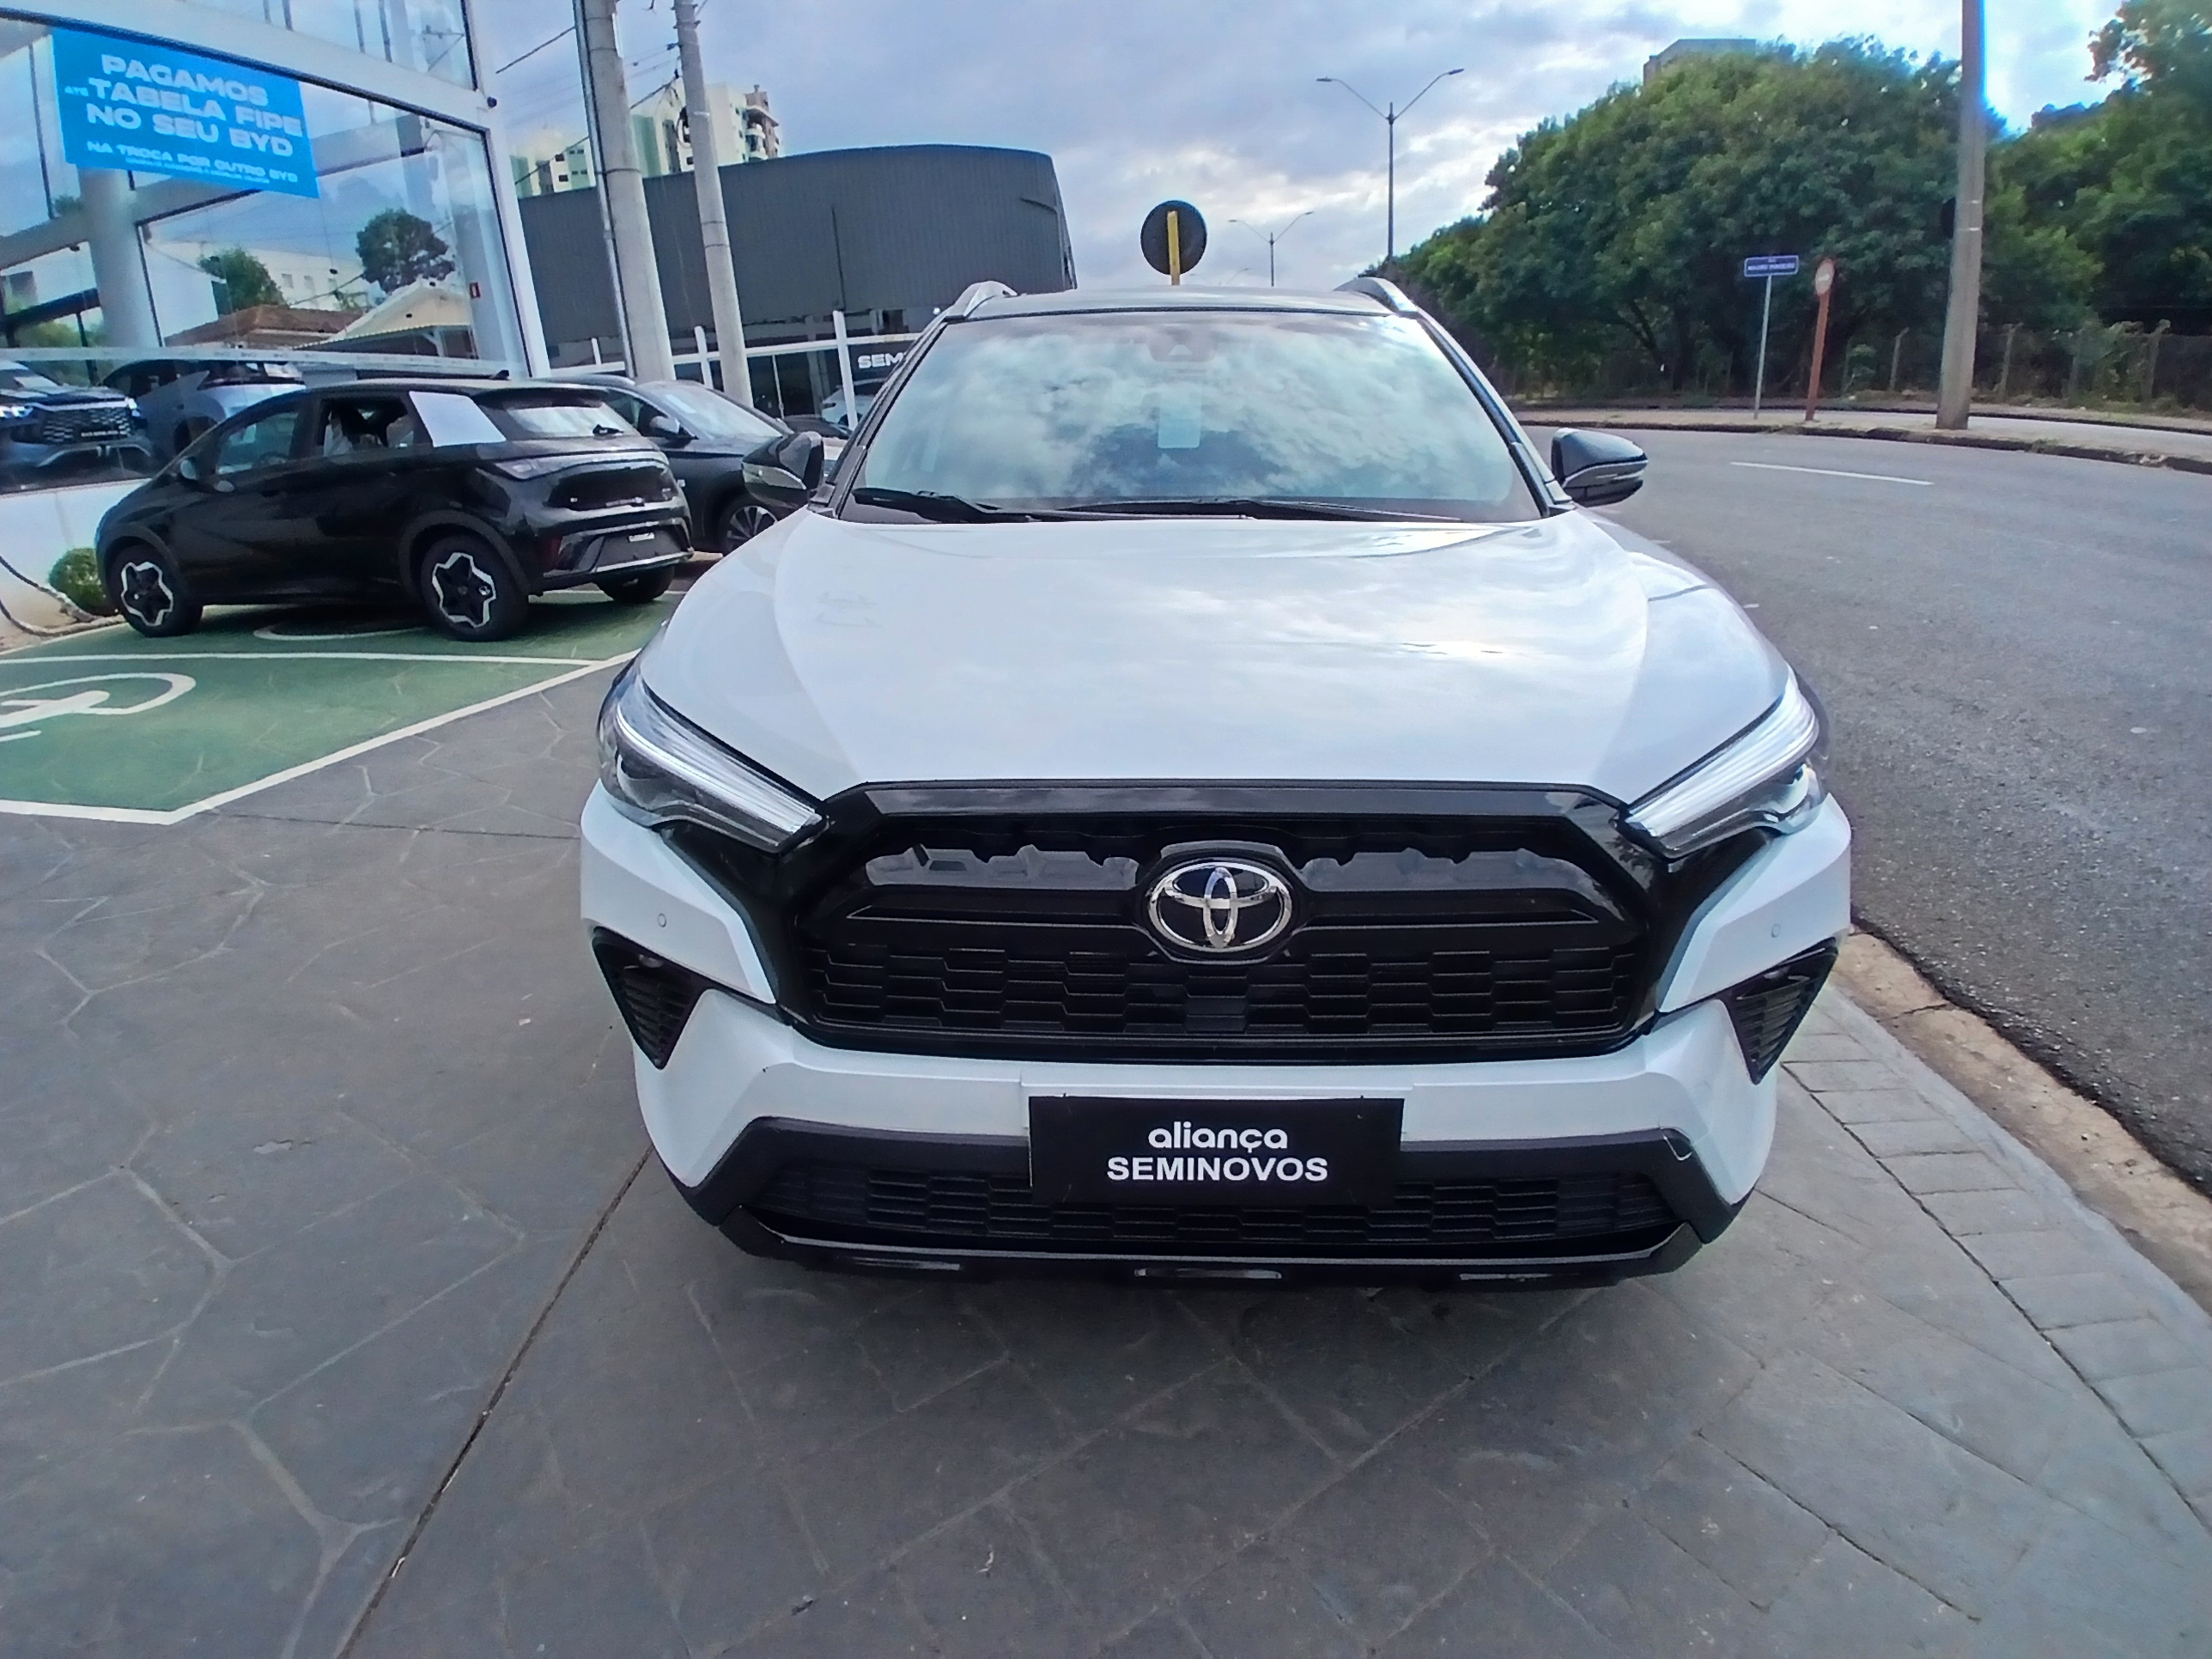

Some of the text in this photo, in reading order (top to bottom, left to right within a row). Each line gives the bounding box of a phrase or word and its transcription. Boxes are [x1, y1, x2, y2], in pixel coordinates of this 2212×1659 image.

[101, 53, 269, 106] PAGAMOS
[88, 77, 226, 120] TABELA
[234, 105, 303, 137] FIPE
[86, 103, 294, 157] NO SEU BYD
[87, 141, 113, 154] NA
[116, 144, 173, 161] TROCA
[177, 153, 210, 167] POR
[215, 159, 266, 177] OUTRO
[269, 170, 298, 182] BYD
[858, 351, 904, 368] SEM
[1148, 1121, 1288, 1153] aliança
[1107, 1157, 1328, 1182] SEMINOVOS
